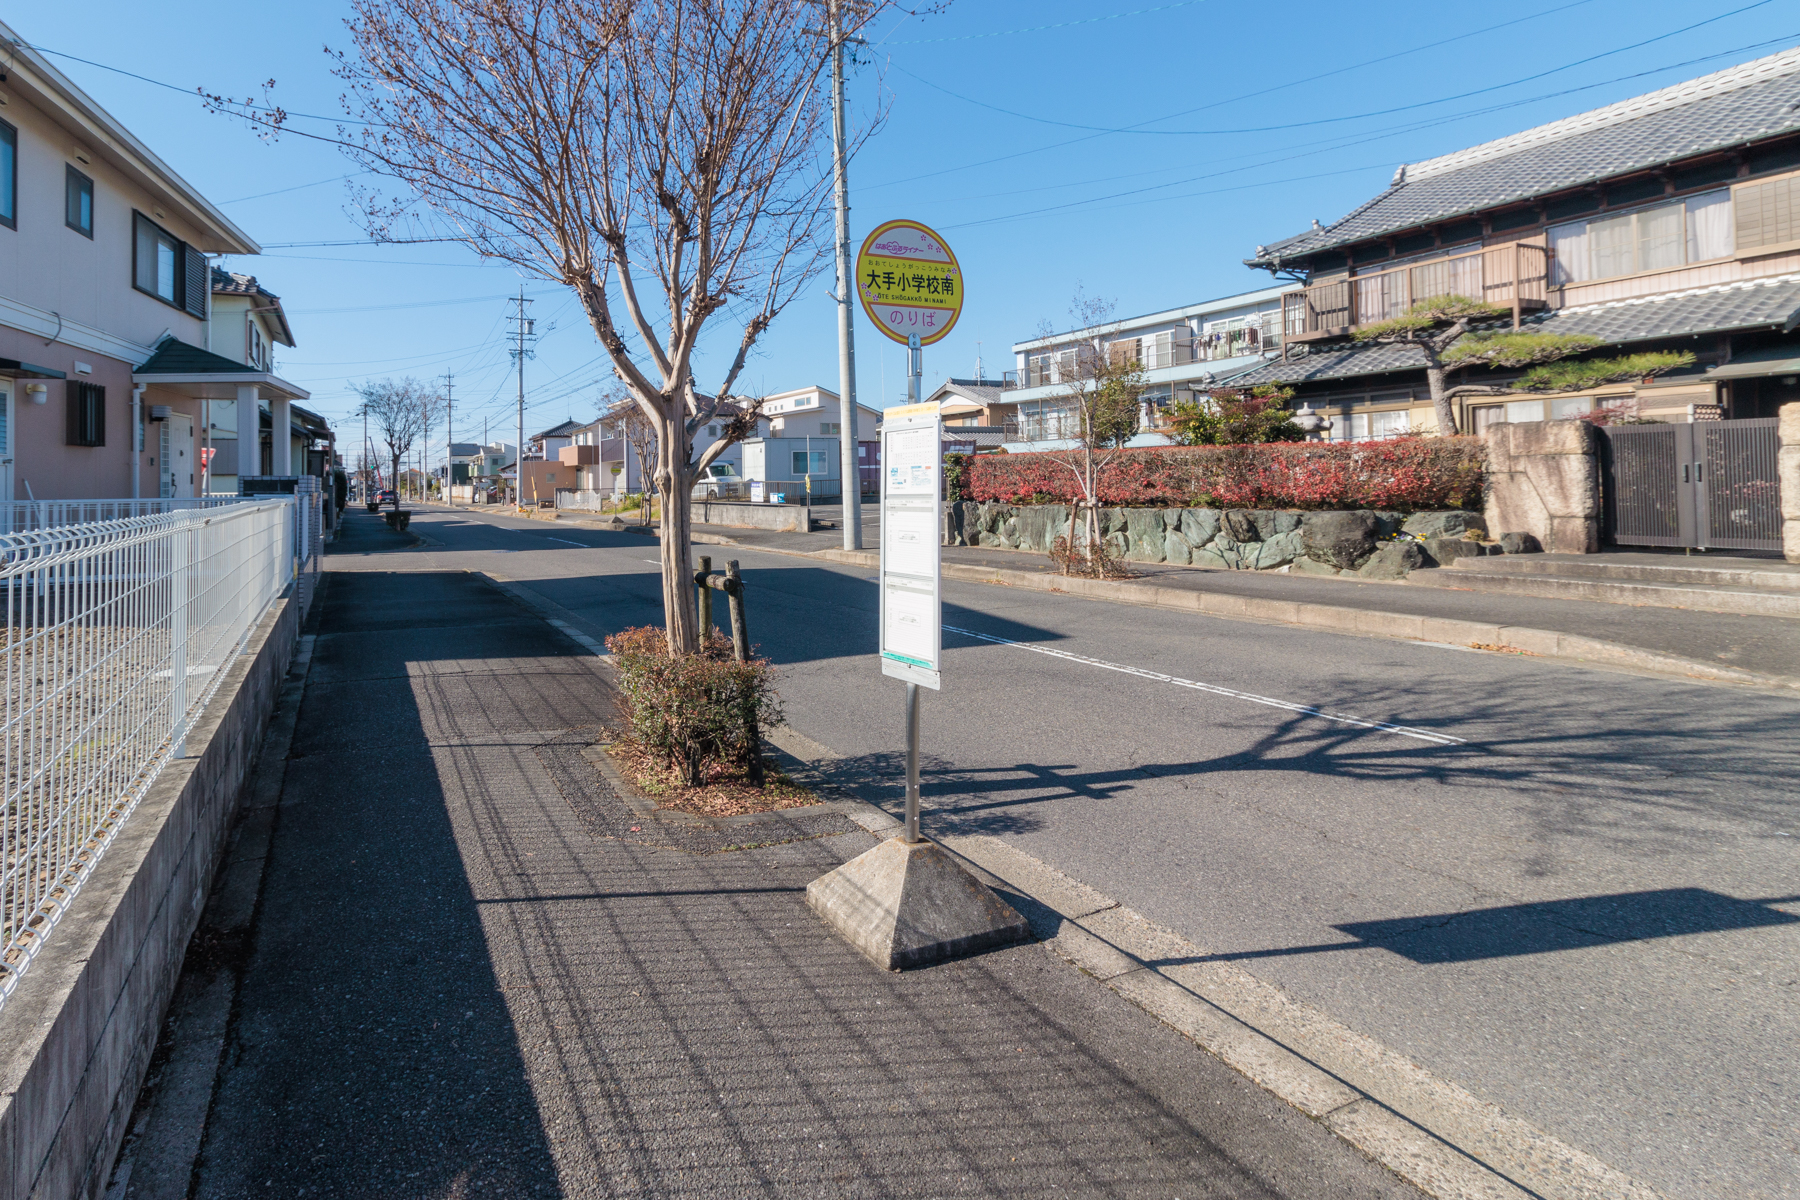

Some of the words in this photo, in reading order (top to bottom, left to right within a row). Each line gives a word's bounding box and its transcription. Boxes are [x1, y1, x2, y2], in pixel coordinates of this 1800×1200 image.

[868, 259, 952, 273] おおてしょうがっこうみなみ
[867, 269, 954, 296] 大手小学校南
[890, 310, 936, 327] のりば
